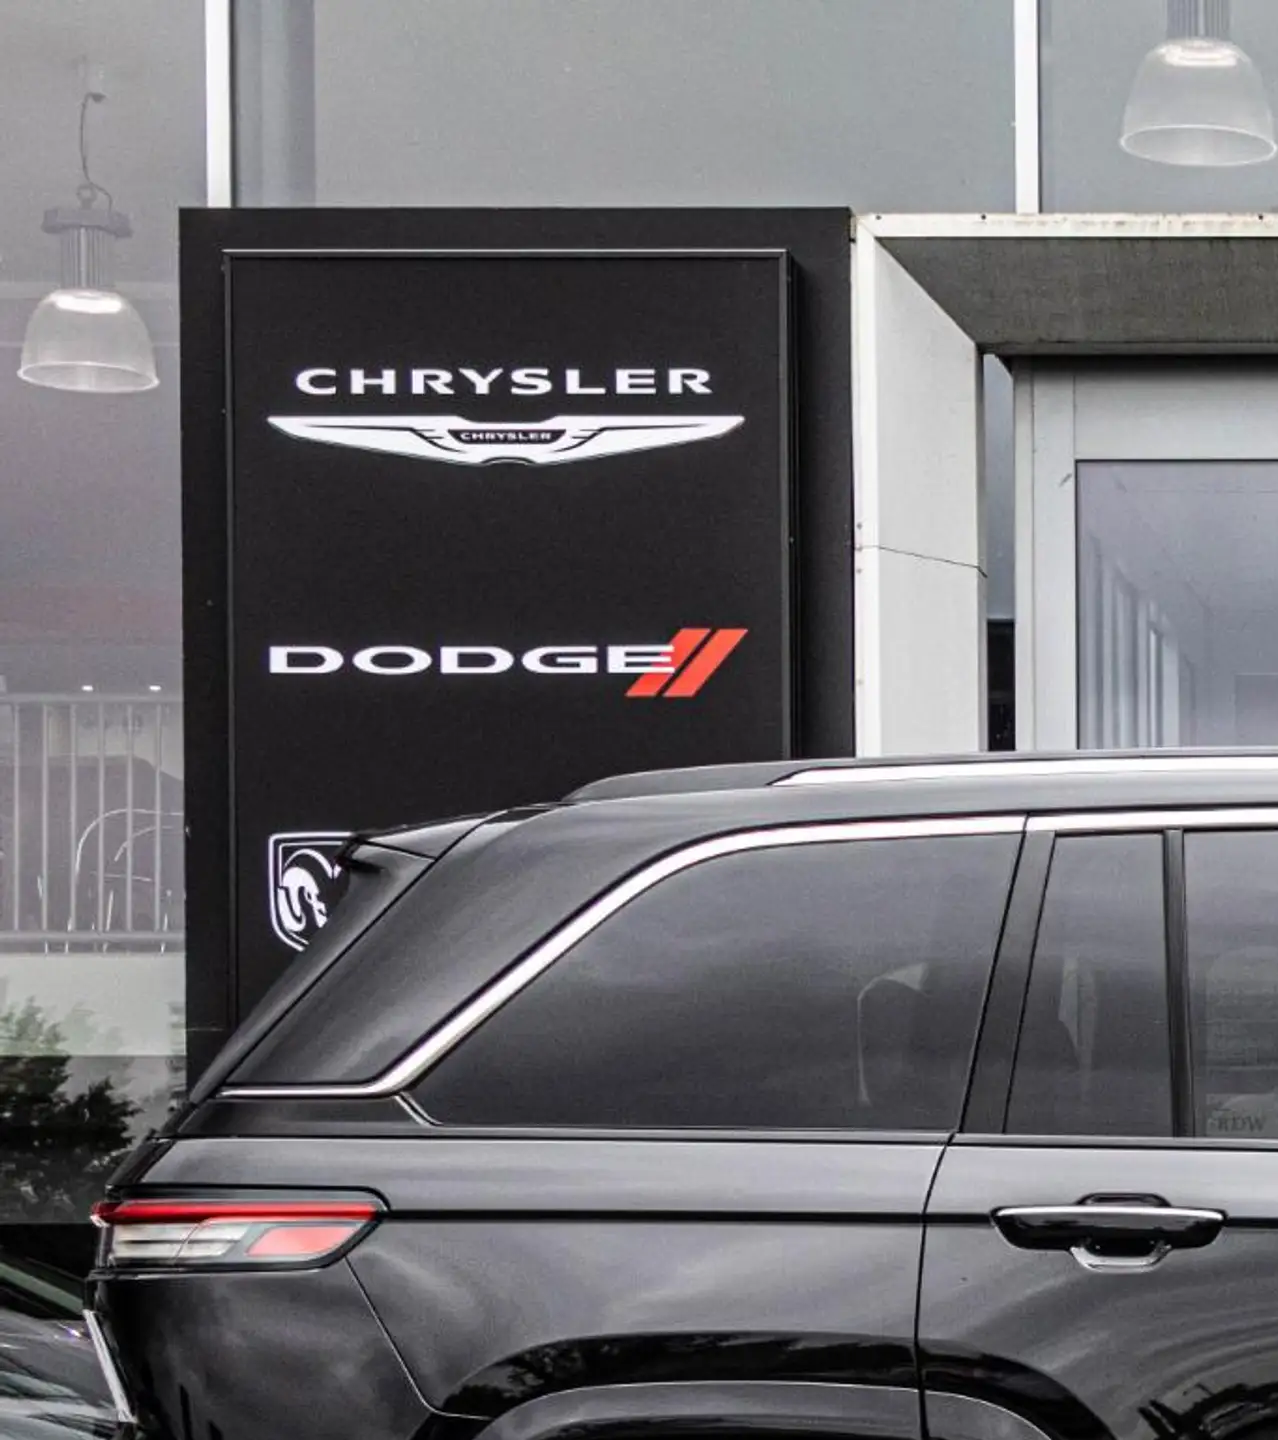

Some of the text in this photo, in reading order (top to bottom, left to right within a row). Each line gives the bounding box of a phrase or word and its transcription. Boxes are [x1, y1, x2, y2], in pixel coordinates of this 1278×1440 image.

[296, 367, 712, 395] CHRYSLER
[460, 431, 552, 442] CHRYSLER
[269, 644, 676, 675] DODGE
